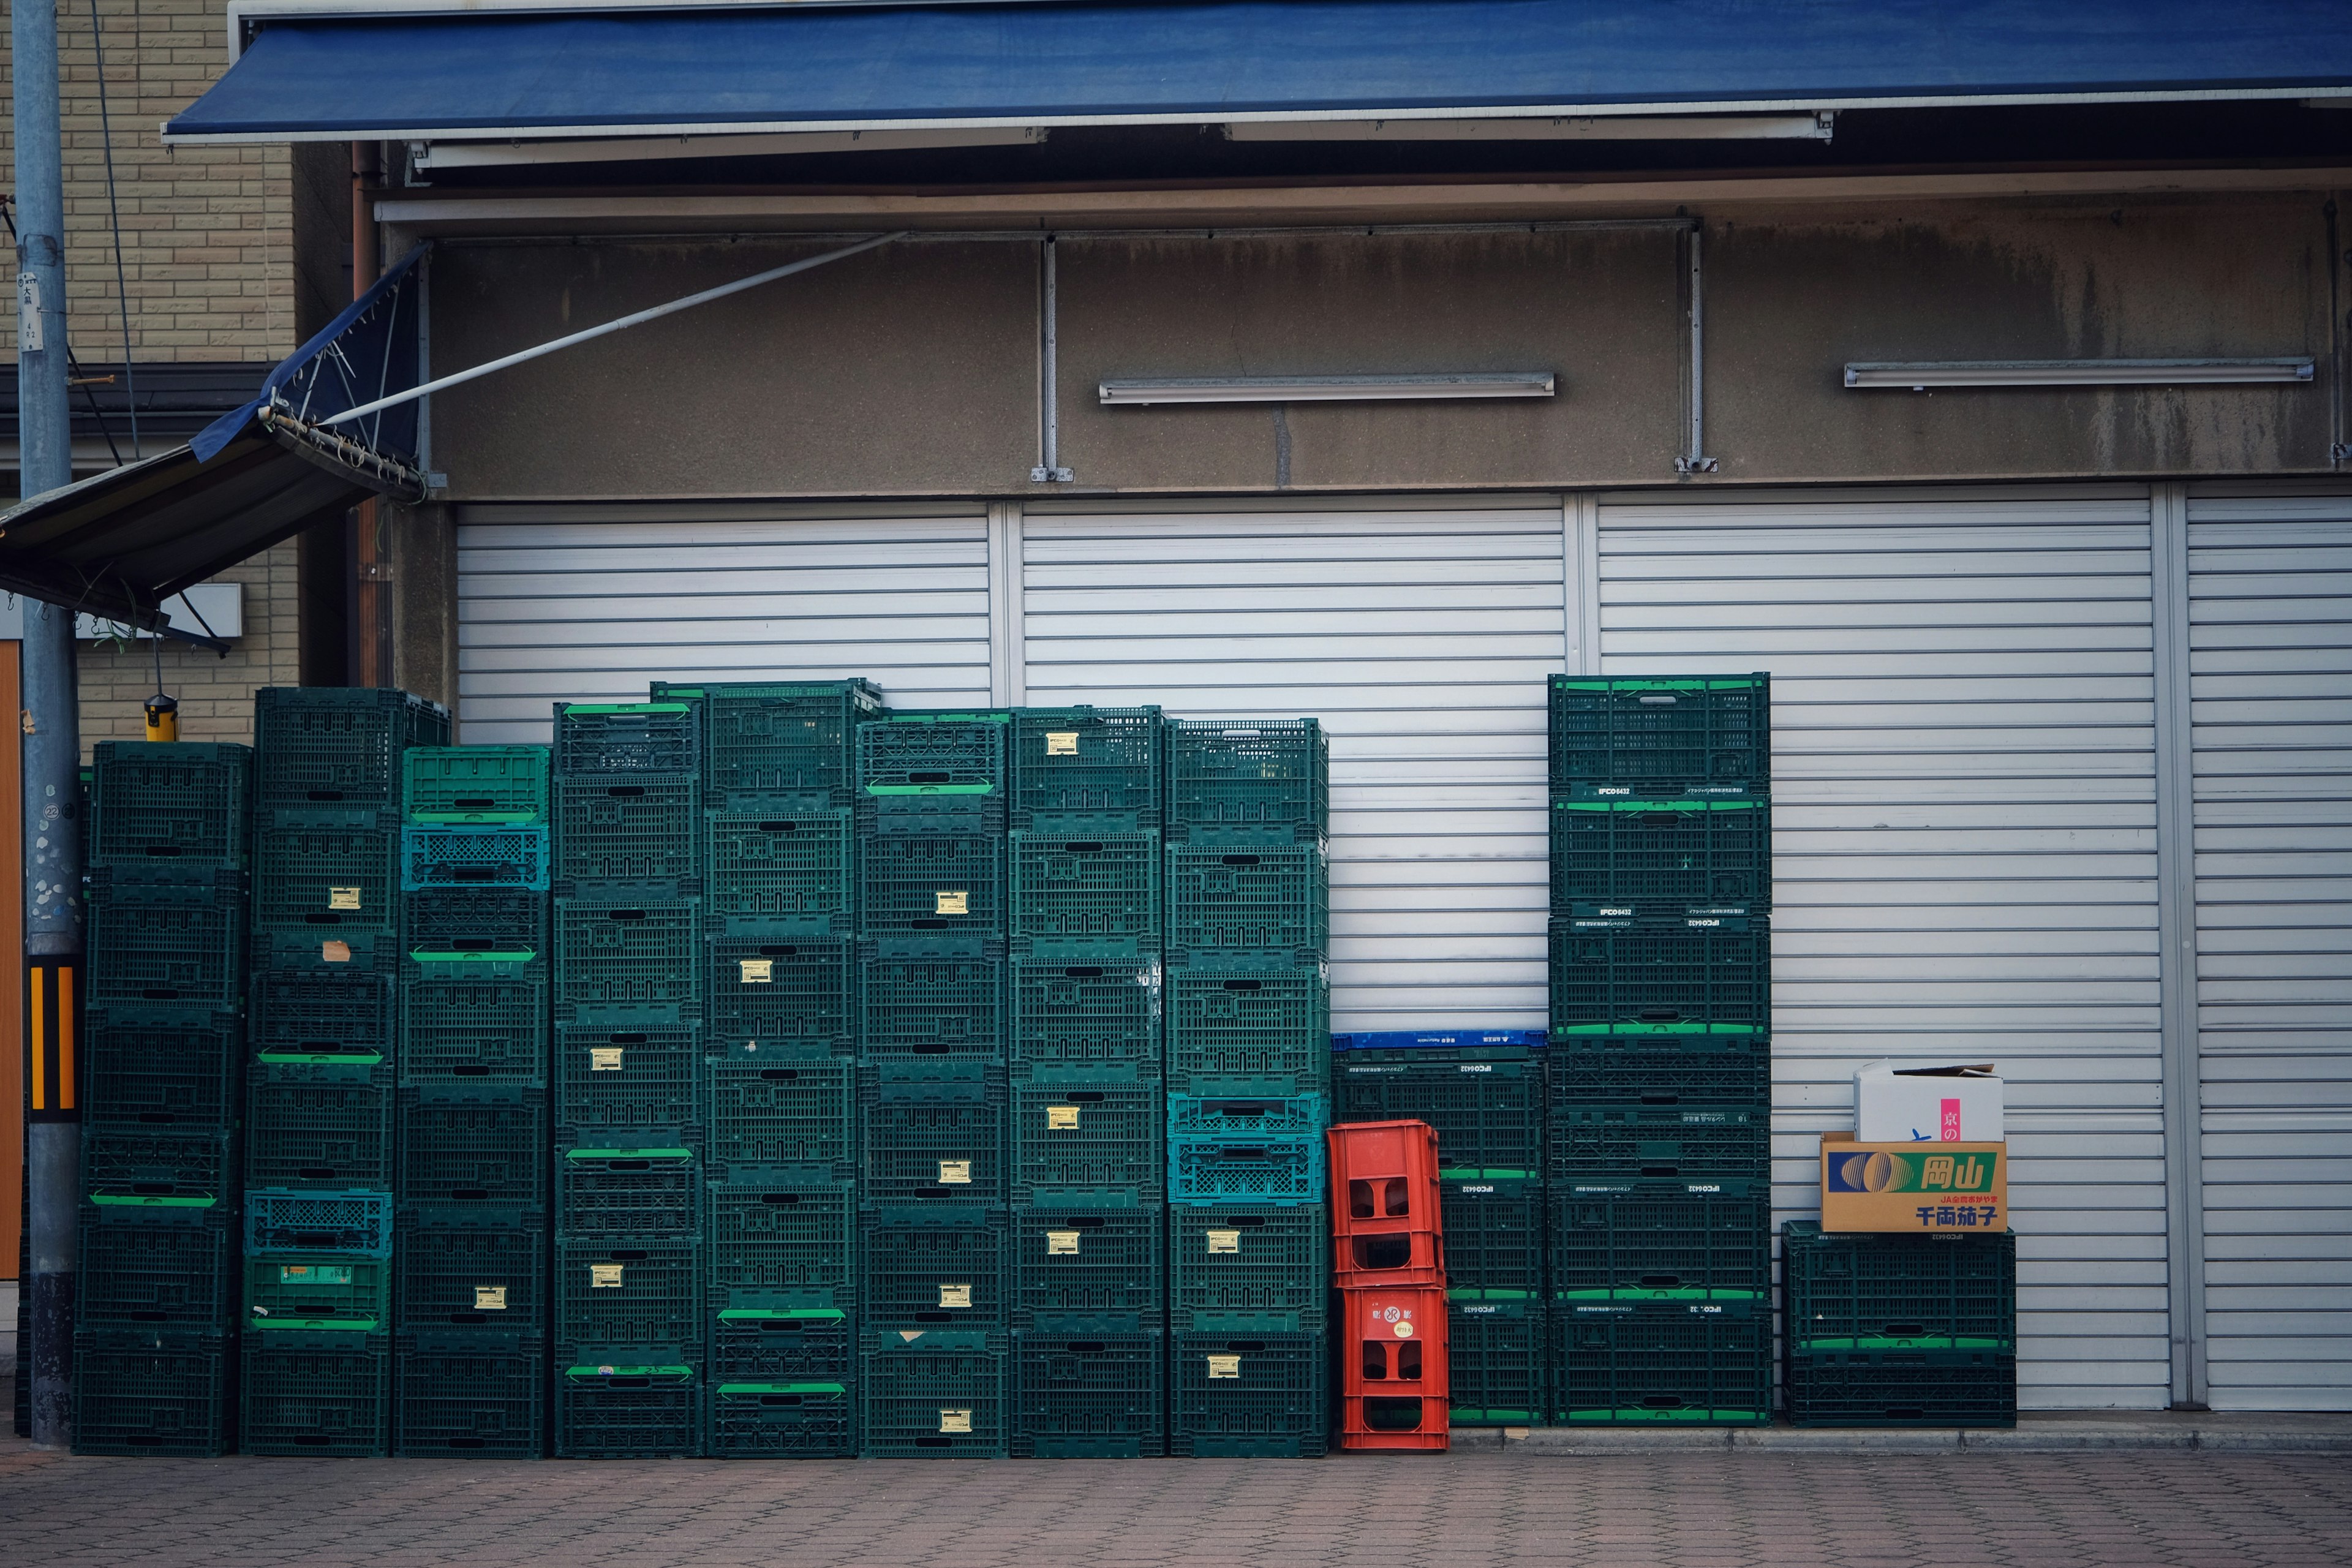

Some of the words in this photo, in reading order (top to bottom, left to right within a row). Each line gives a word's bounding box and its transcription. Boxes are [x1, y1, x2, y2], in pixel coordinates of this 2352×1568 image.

[46, 807, 58, 816] 22
[1944, 1112, 1958, 1140] 京の
[1921, 1156, 1985, 1189] 岡山
[1916, 1206, 1998, 1227] 千両茄子
